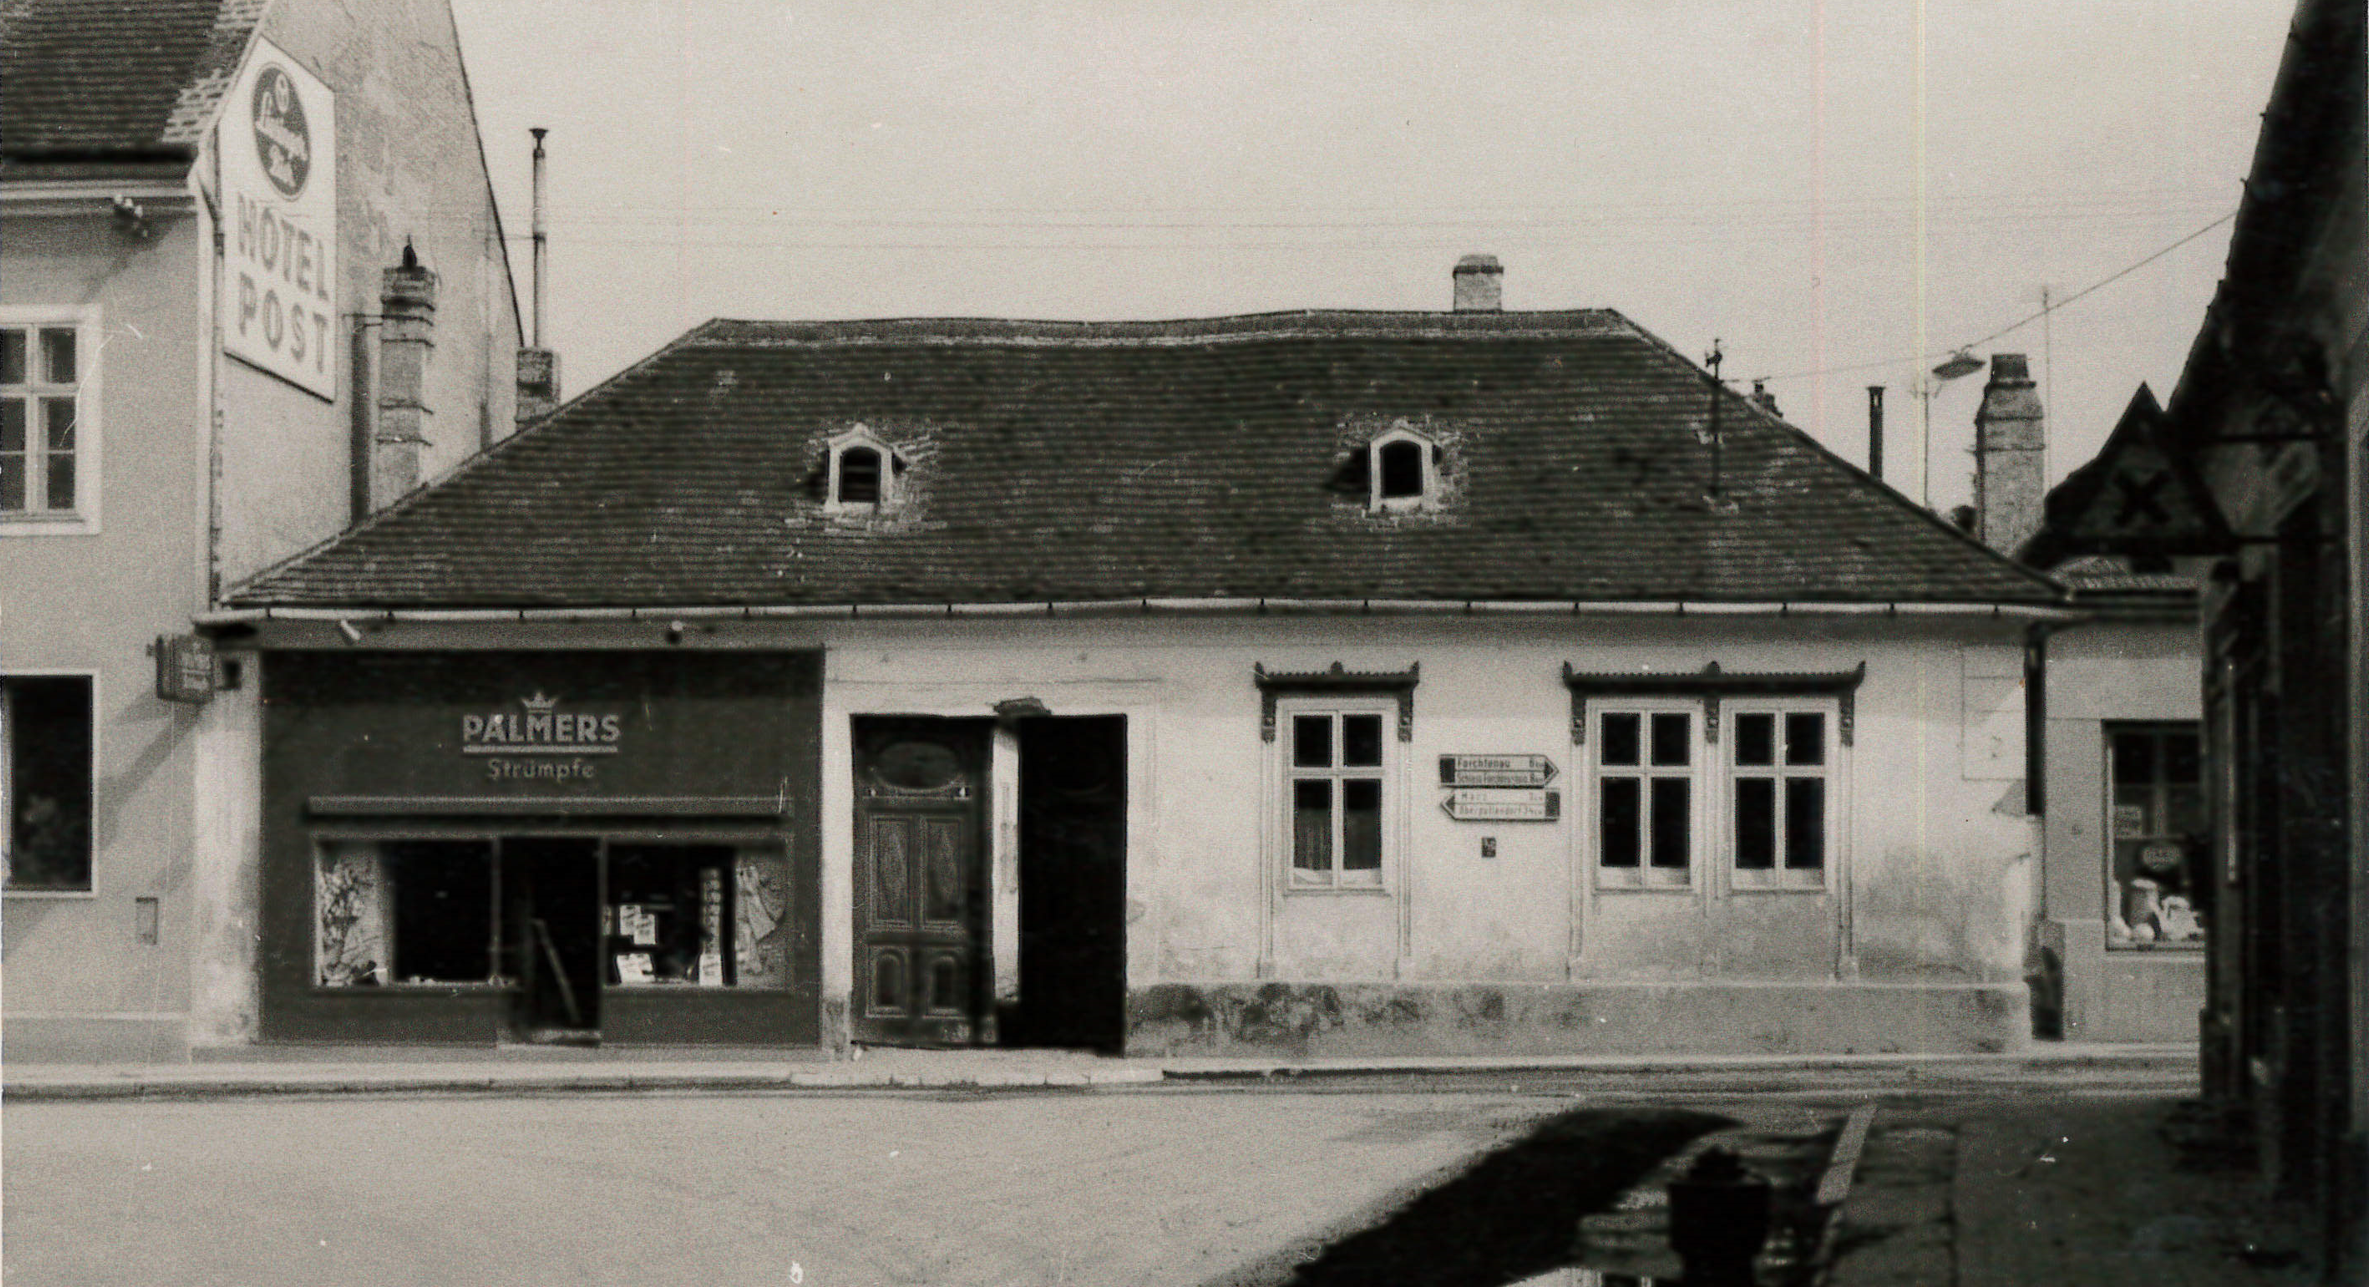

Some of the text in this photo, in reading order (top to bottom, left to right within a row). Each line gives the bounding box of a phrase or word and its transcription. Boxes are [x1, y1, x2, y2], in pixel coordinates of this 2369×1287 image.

[238, 192, 328, 301] HOTEL
[238, 271, 328, 374] POST
[463, 714, 621, 742] PALMERS
[487, 758, 595, 783] Strümpfe
